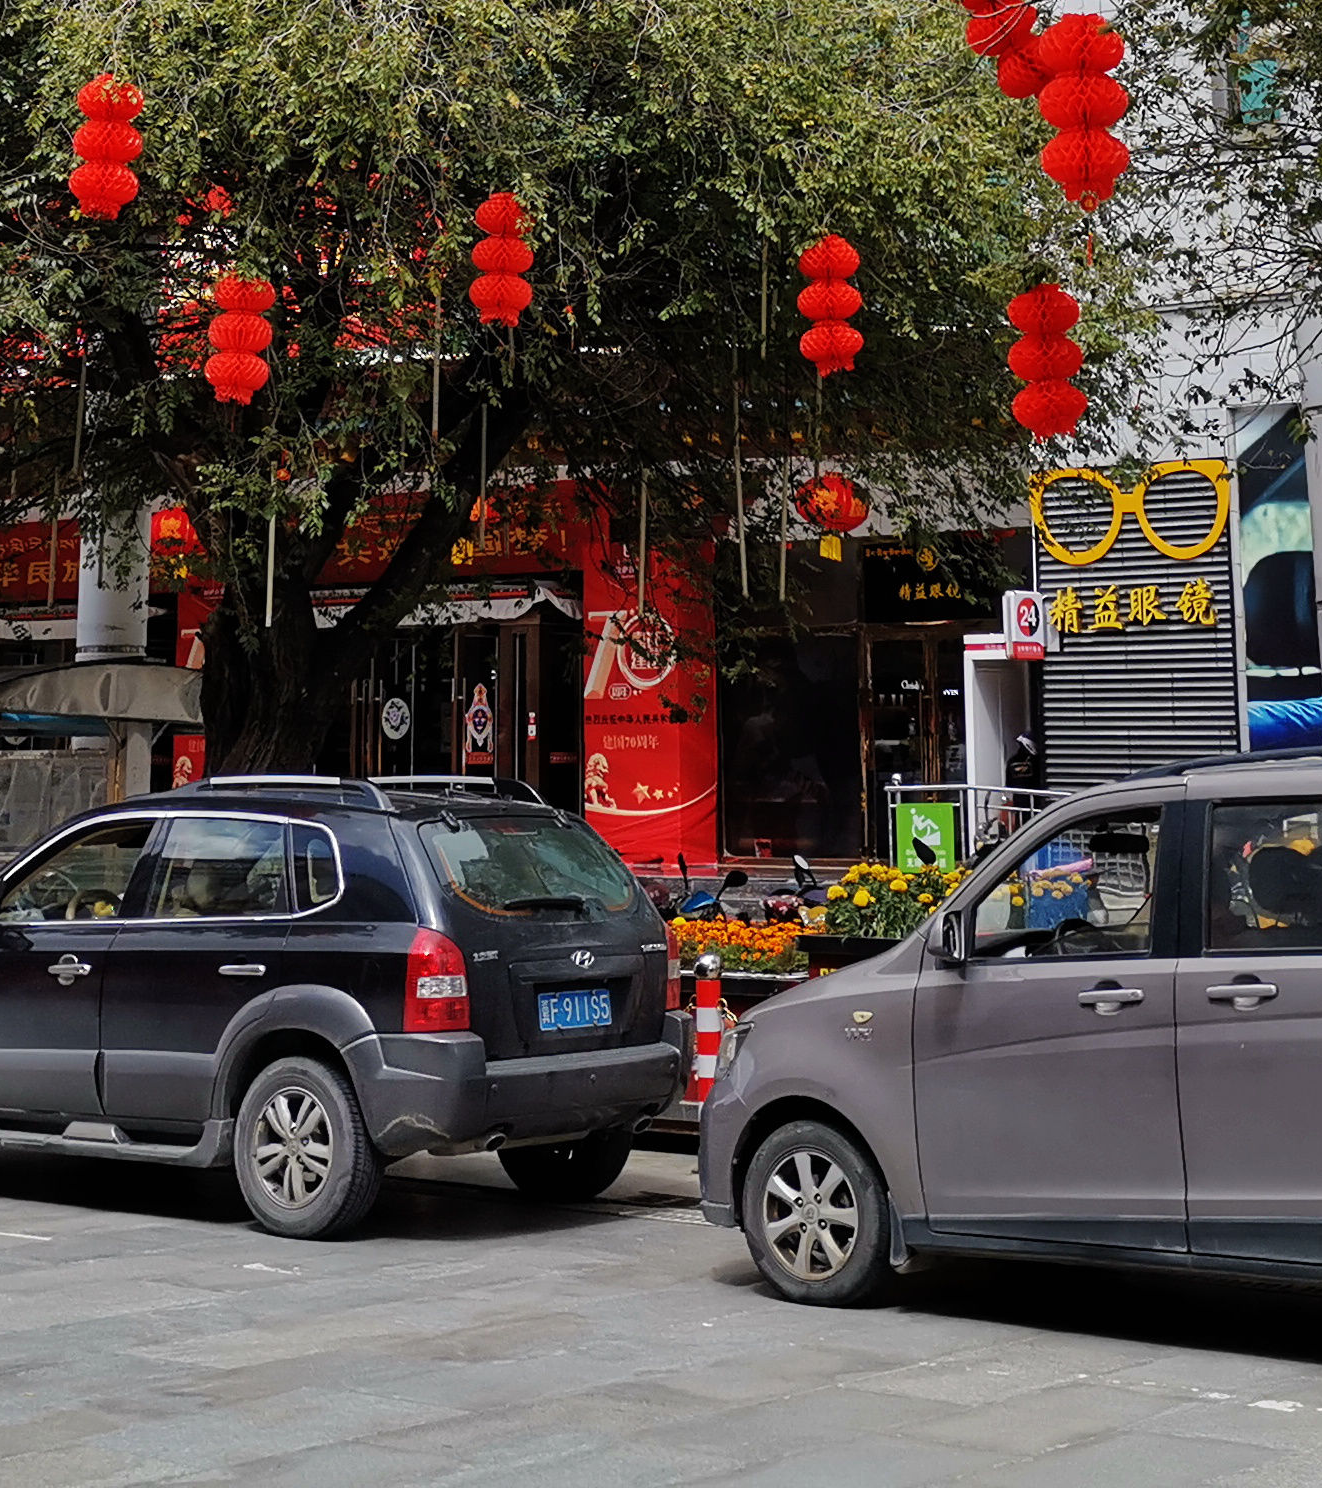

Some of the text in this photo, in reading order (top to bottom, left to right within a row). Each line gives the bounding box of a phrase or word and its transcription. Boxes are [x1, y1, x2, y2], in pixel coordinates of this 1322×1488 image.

[1019, 604, 1037, 628] 24
[1048, 576, 1219, 634] 精益眼镜
[603, 734, 660, 750] 建国70周年
